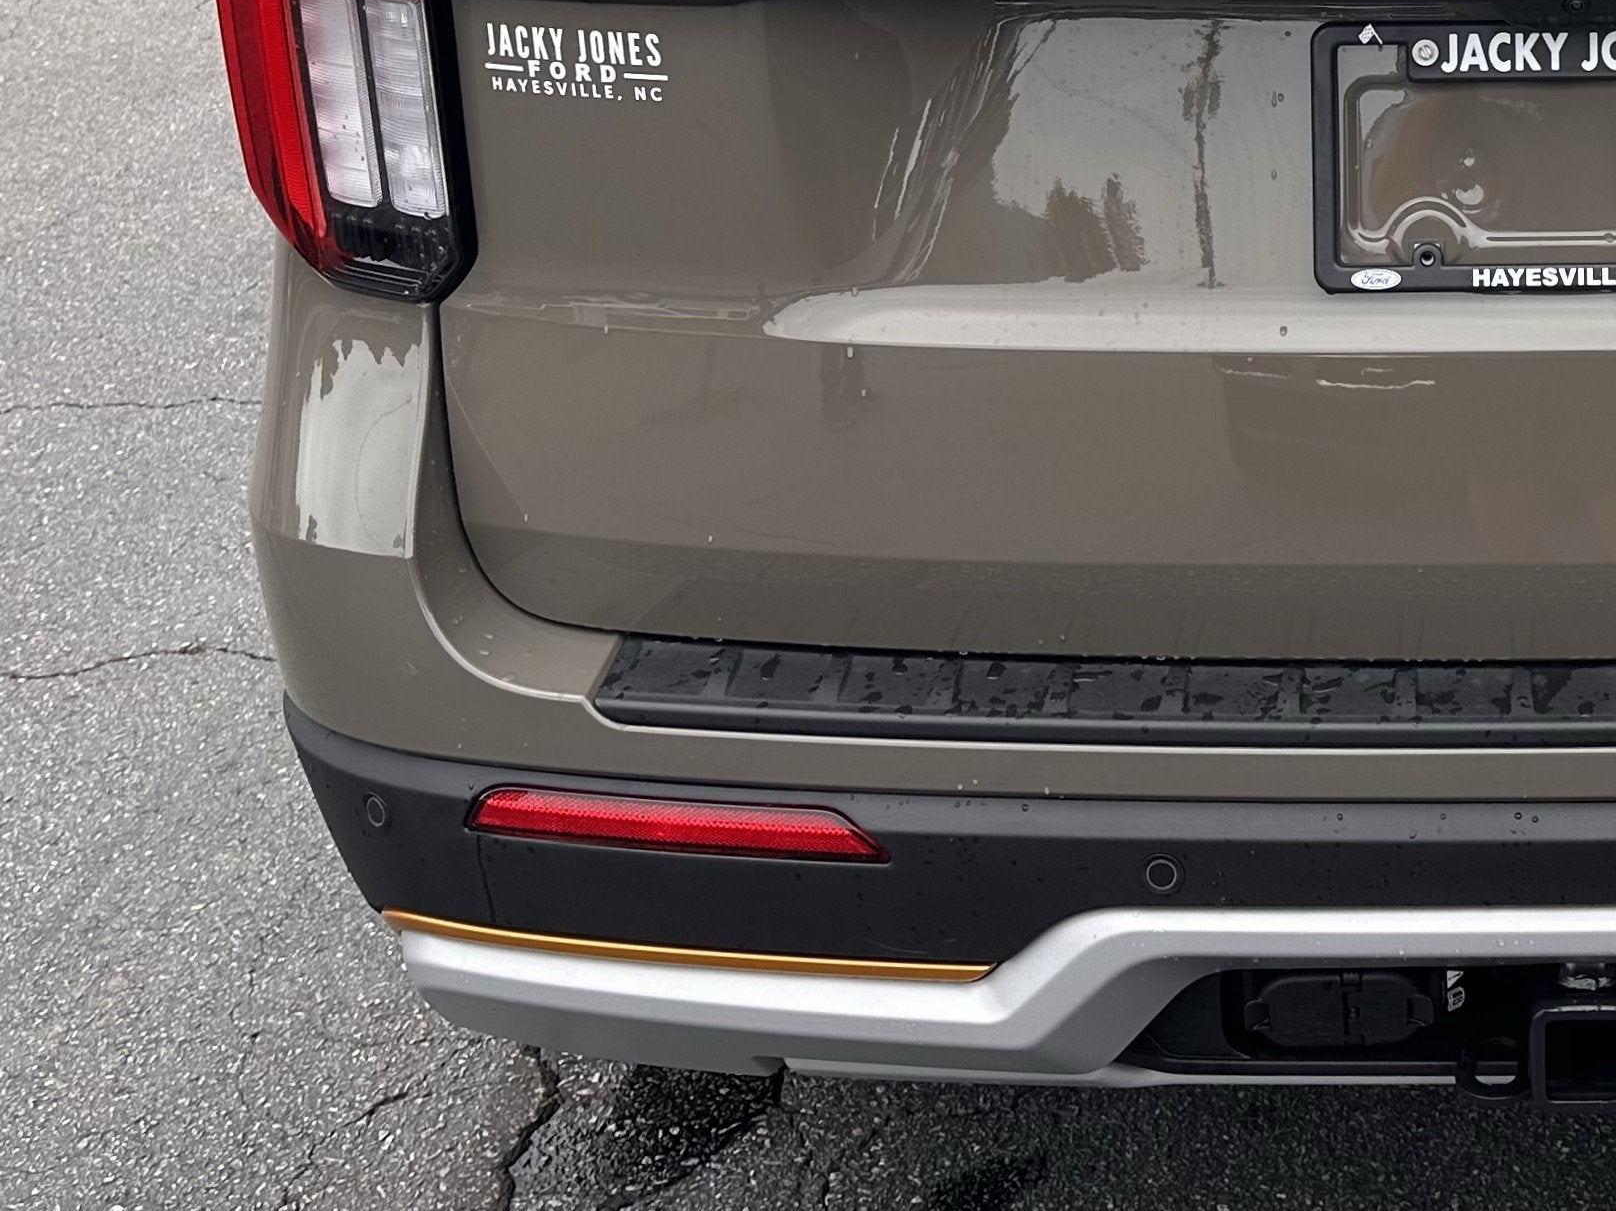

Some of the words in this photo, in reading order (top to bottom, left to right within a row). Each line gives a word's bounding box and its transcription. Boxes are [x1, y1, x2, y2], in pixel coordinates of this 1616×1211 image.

[486, 22, 563, 62] JACKY
[578, 29, 662, 67] JONES
[1441, 32, 1568, 74] JACKY
[528, 60, 617, 83] FORD
[491, 76, 623, 101] HAYESVILLE,
[634, 87, 664, 102] NC
